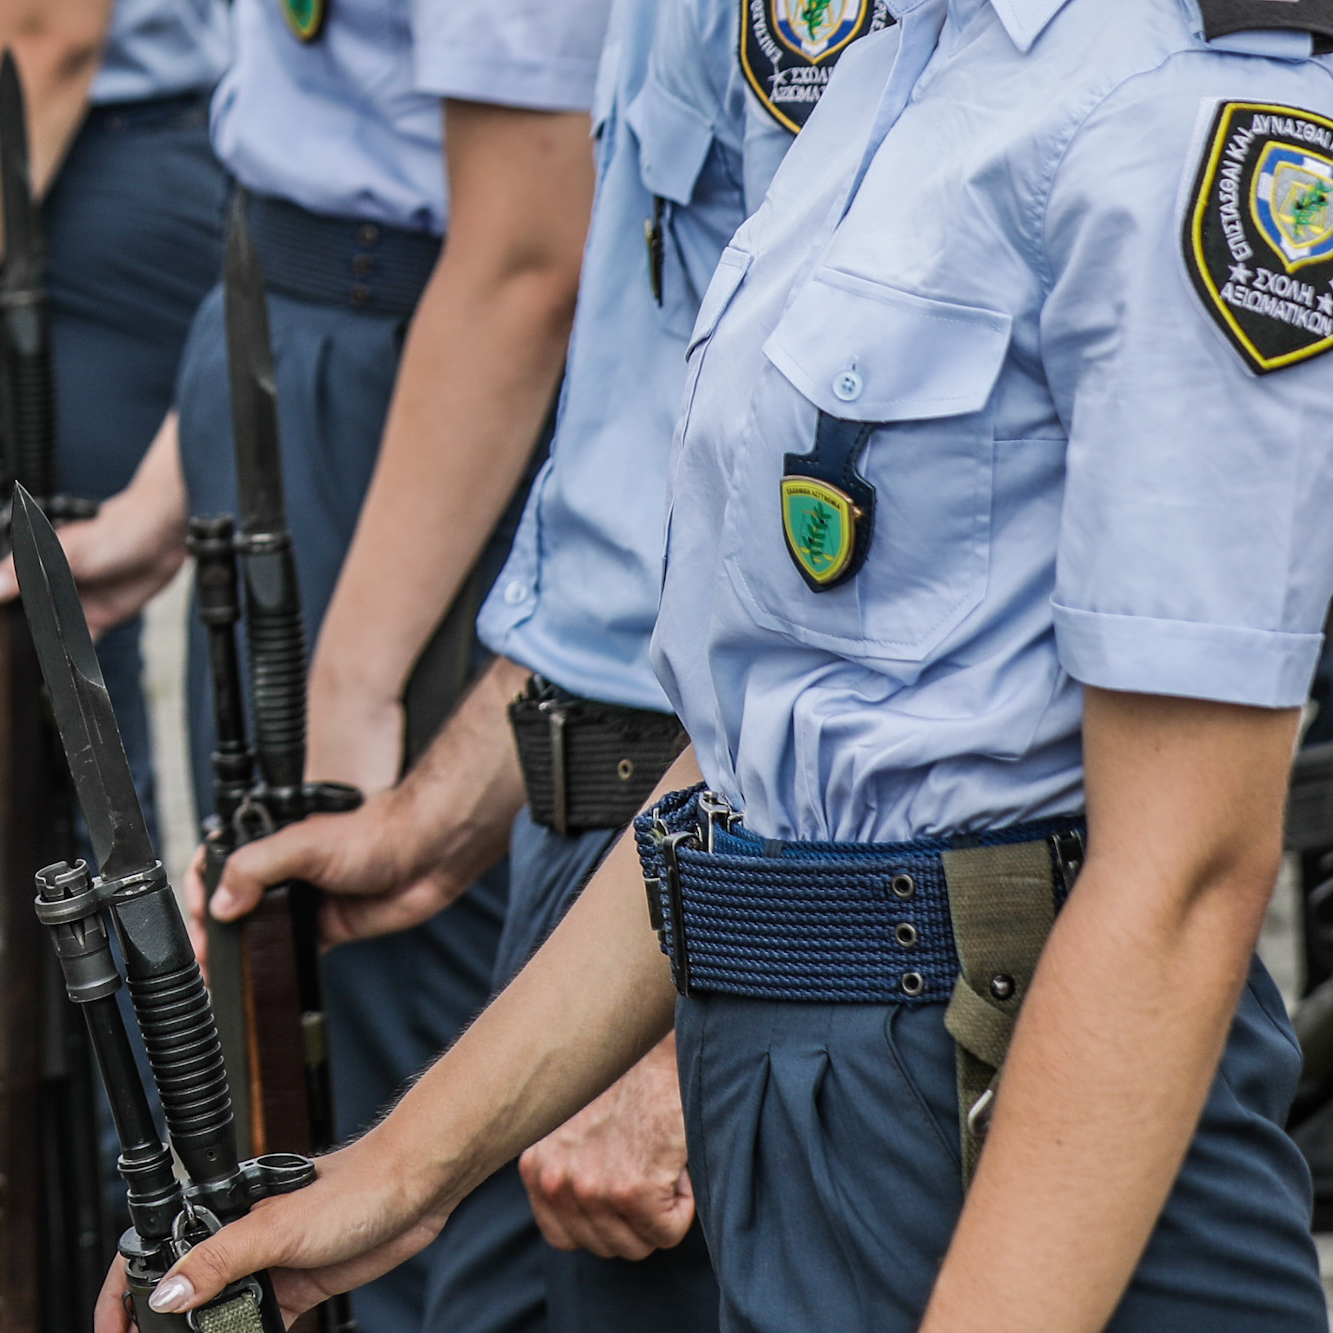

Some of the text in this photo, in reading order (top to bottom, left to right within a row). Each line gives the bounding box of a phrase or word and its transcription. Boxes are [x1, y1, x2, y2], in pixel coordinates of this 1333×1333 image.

[1219, 114, 1332, 262] ΕΠΙΣΤΑΣΘΑΙ ΚΑΙ ΔΥΝΑΣΘΑΙ
[1252, 267, 1315, 307] ΣΧΟΛΗ
